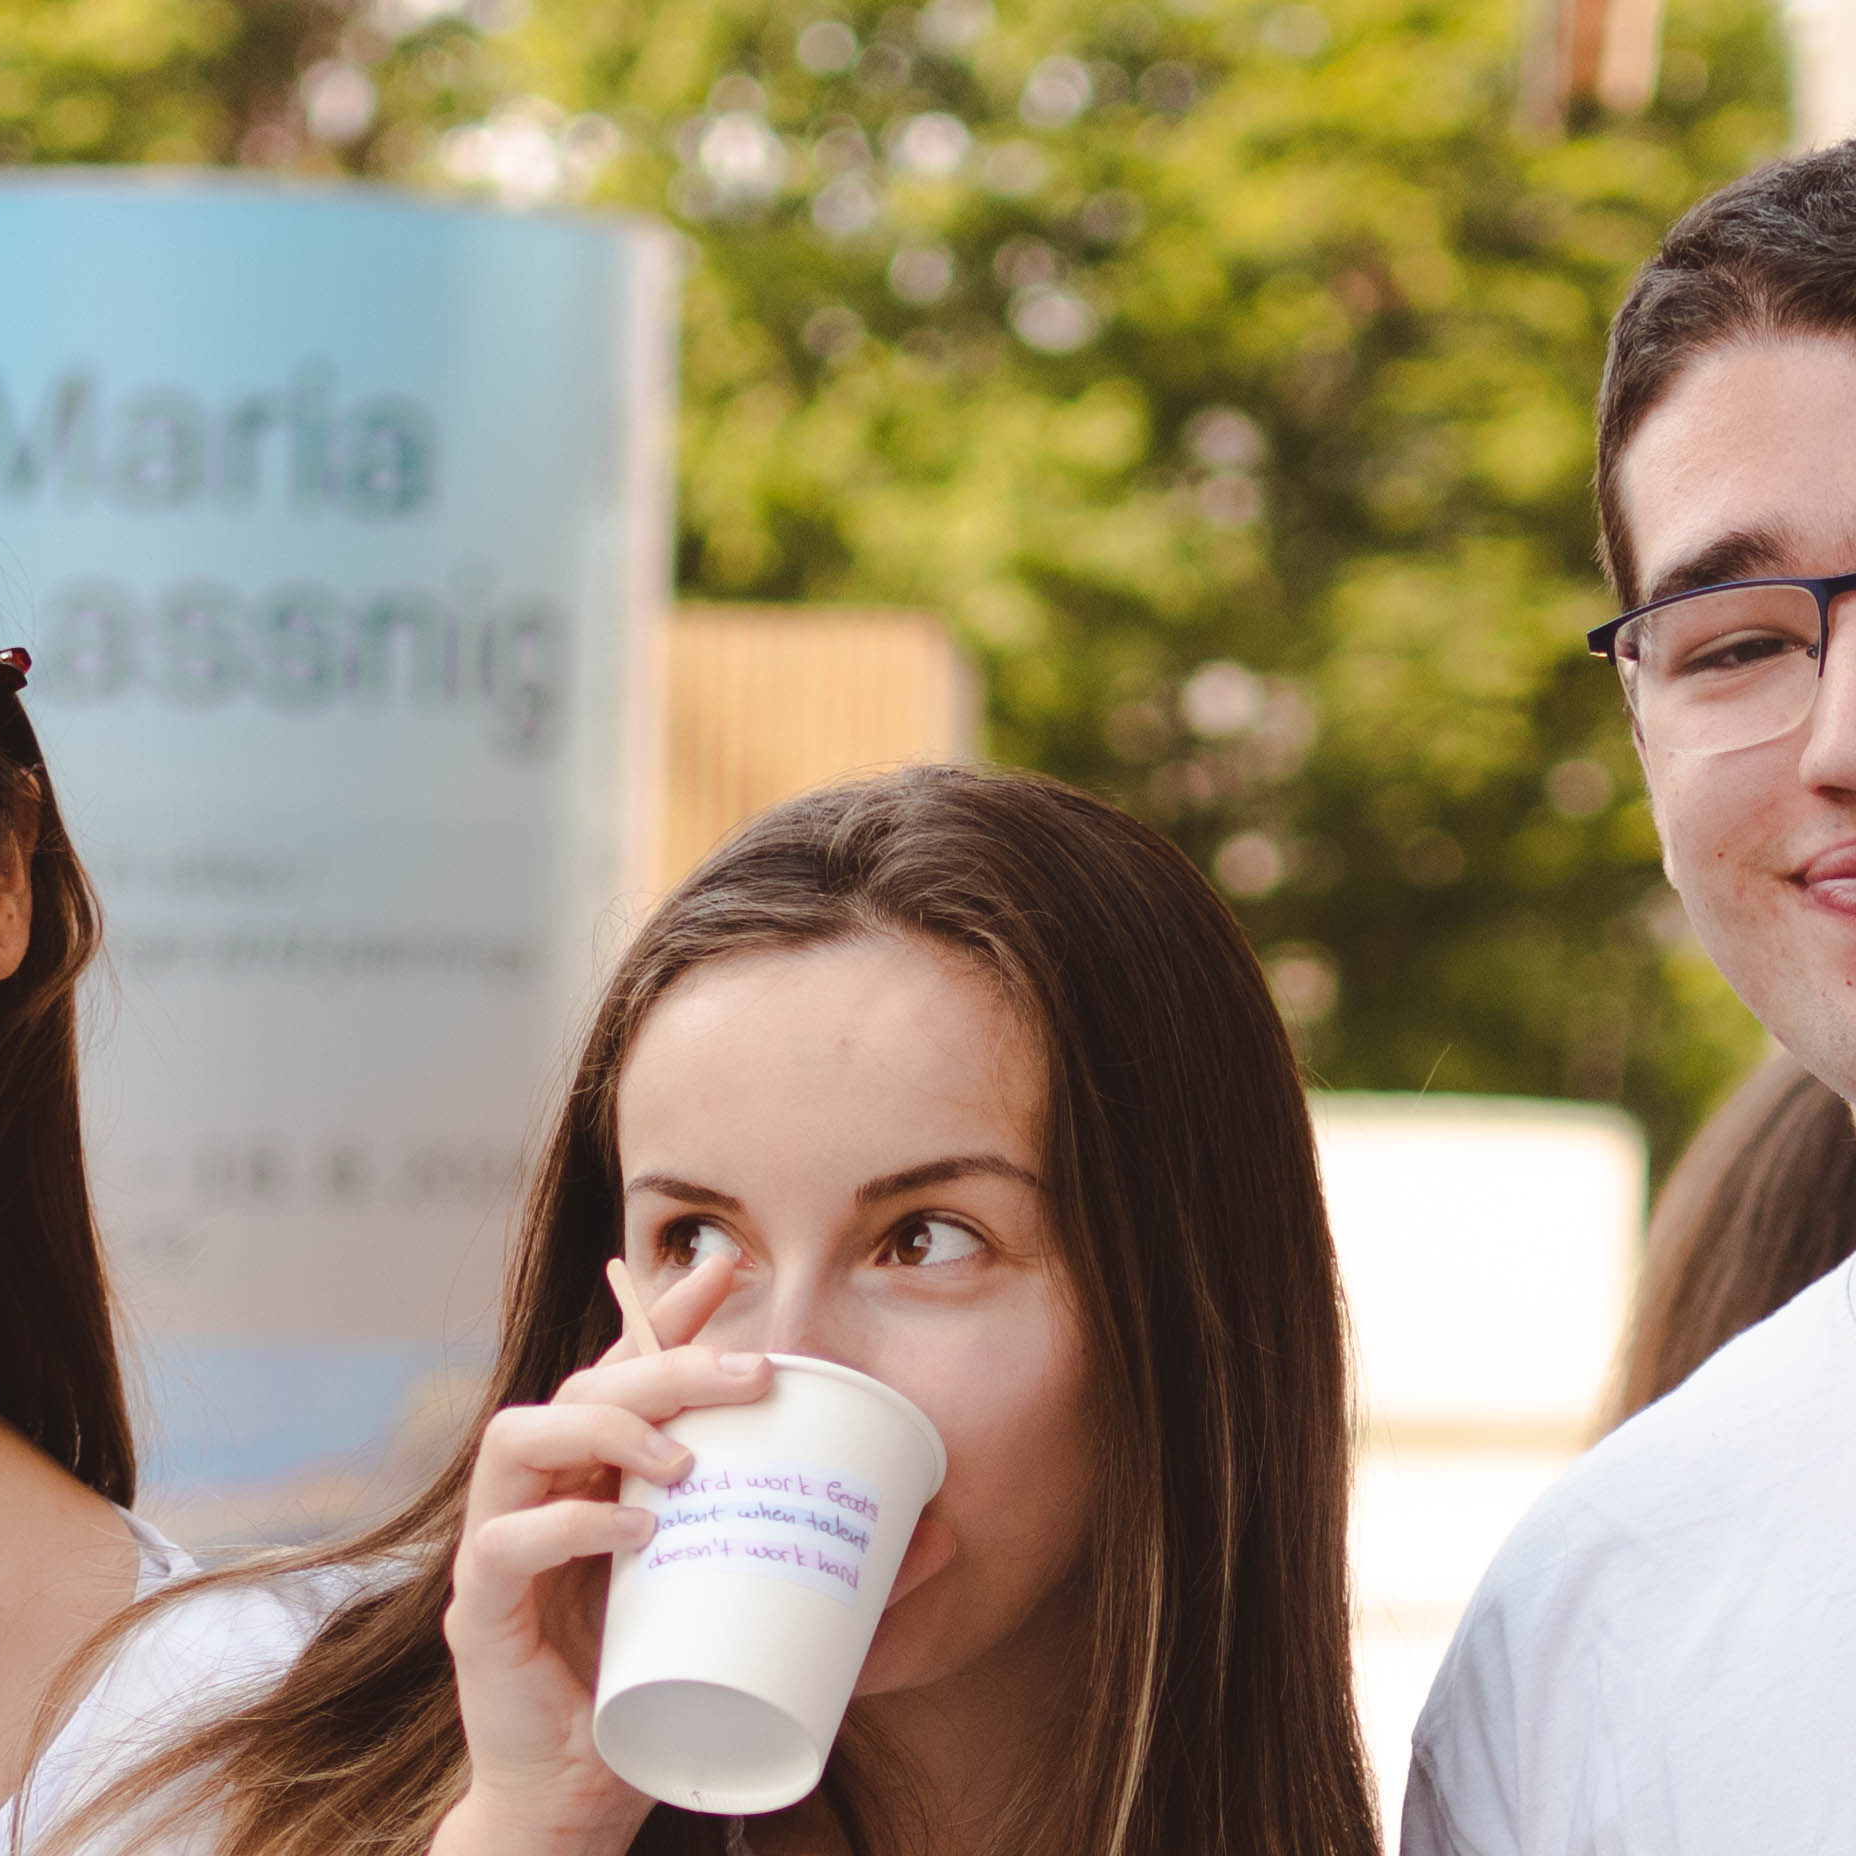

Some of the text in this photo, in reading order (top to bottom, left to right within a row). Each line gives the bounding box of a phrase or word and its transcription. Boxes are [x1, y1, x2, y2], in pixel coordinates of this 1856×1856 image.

[46, 560, 572, 762] assnig
[745, 1474, 813, 1496] work
[658, 1501, 871, 1553] alent when talent
[648, 1537, 861, 1591] doesn't work hard
